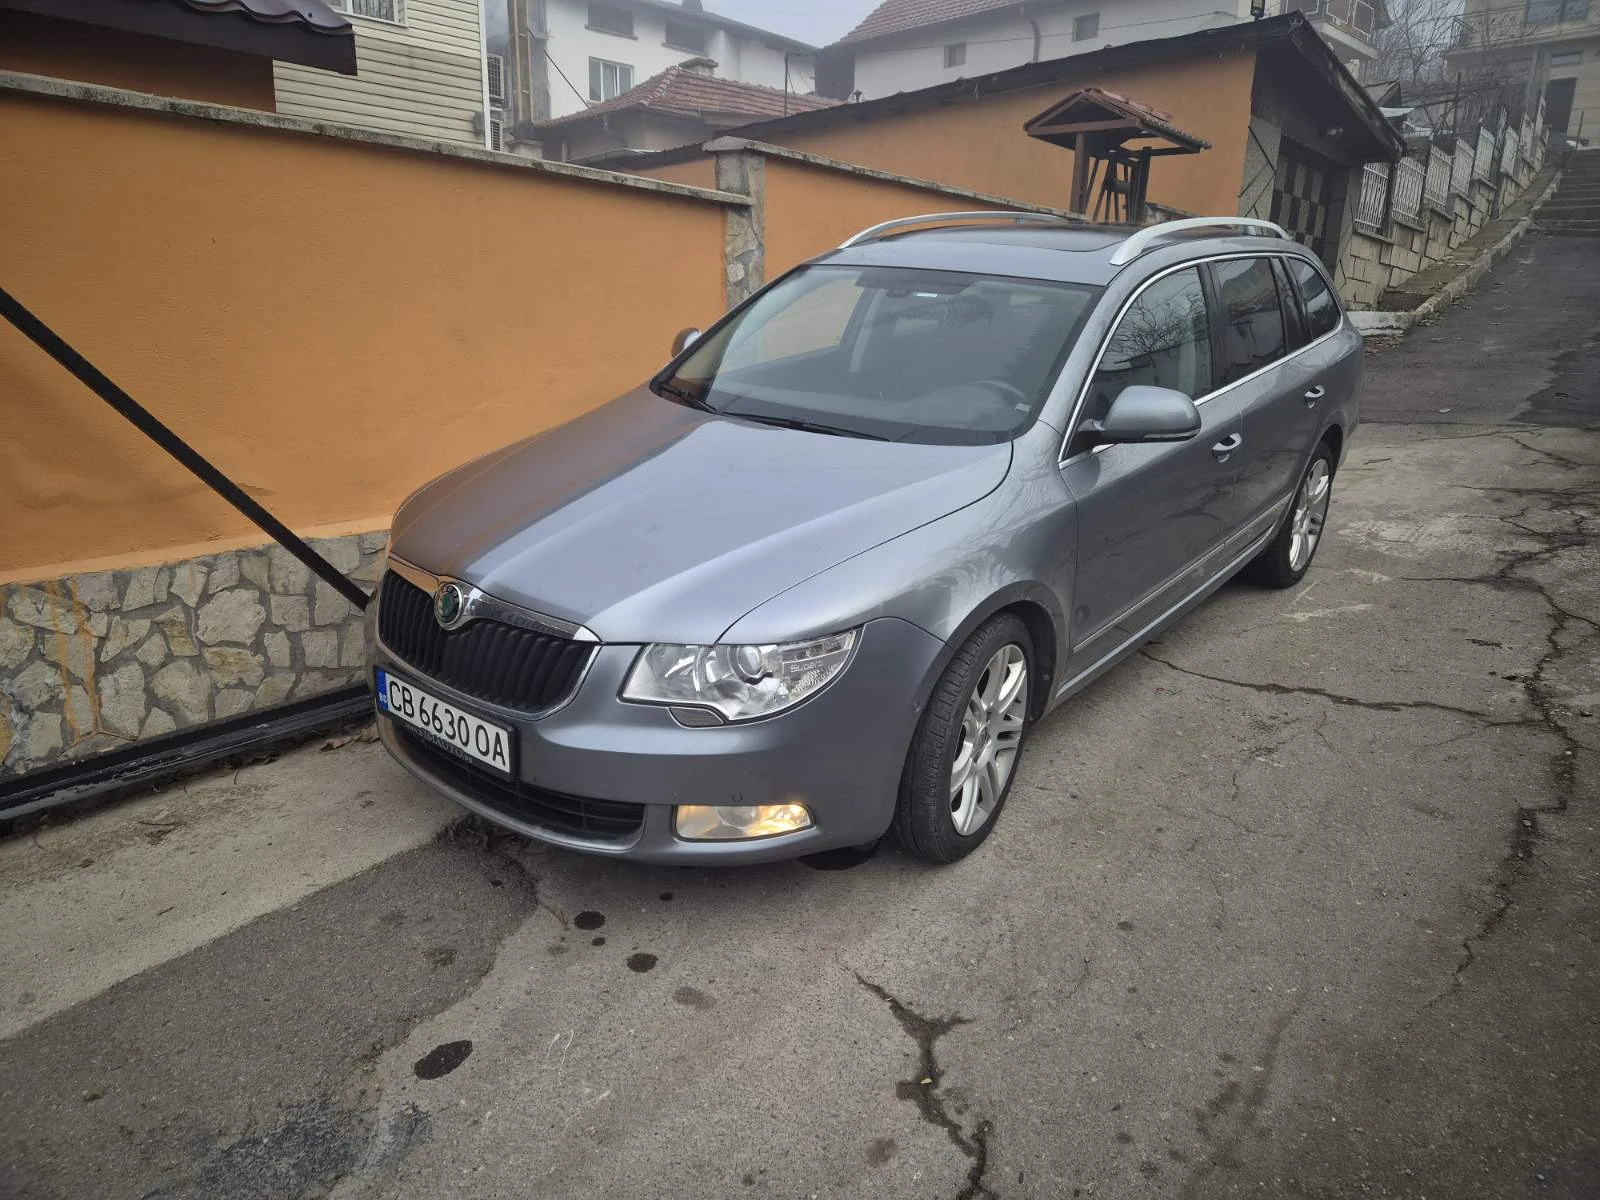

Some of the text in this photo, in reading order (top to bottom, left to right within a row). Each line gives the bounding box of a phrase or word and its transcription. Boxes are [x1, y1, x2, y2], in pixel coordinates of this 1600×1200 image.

[389, 680, 415, 718] CB
[419, 696, 470, 747] 6630
[475, 724, 506, 767] OA
